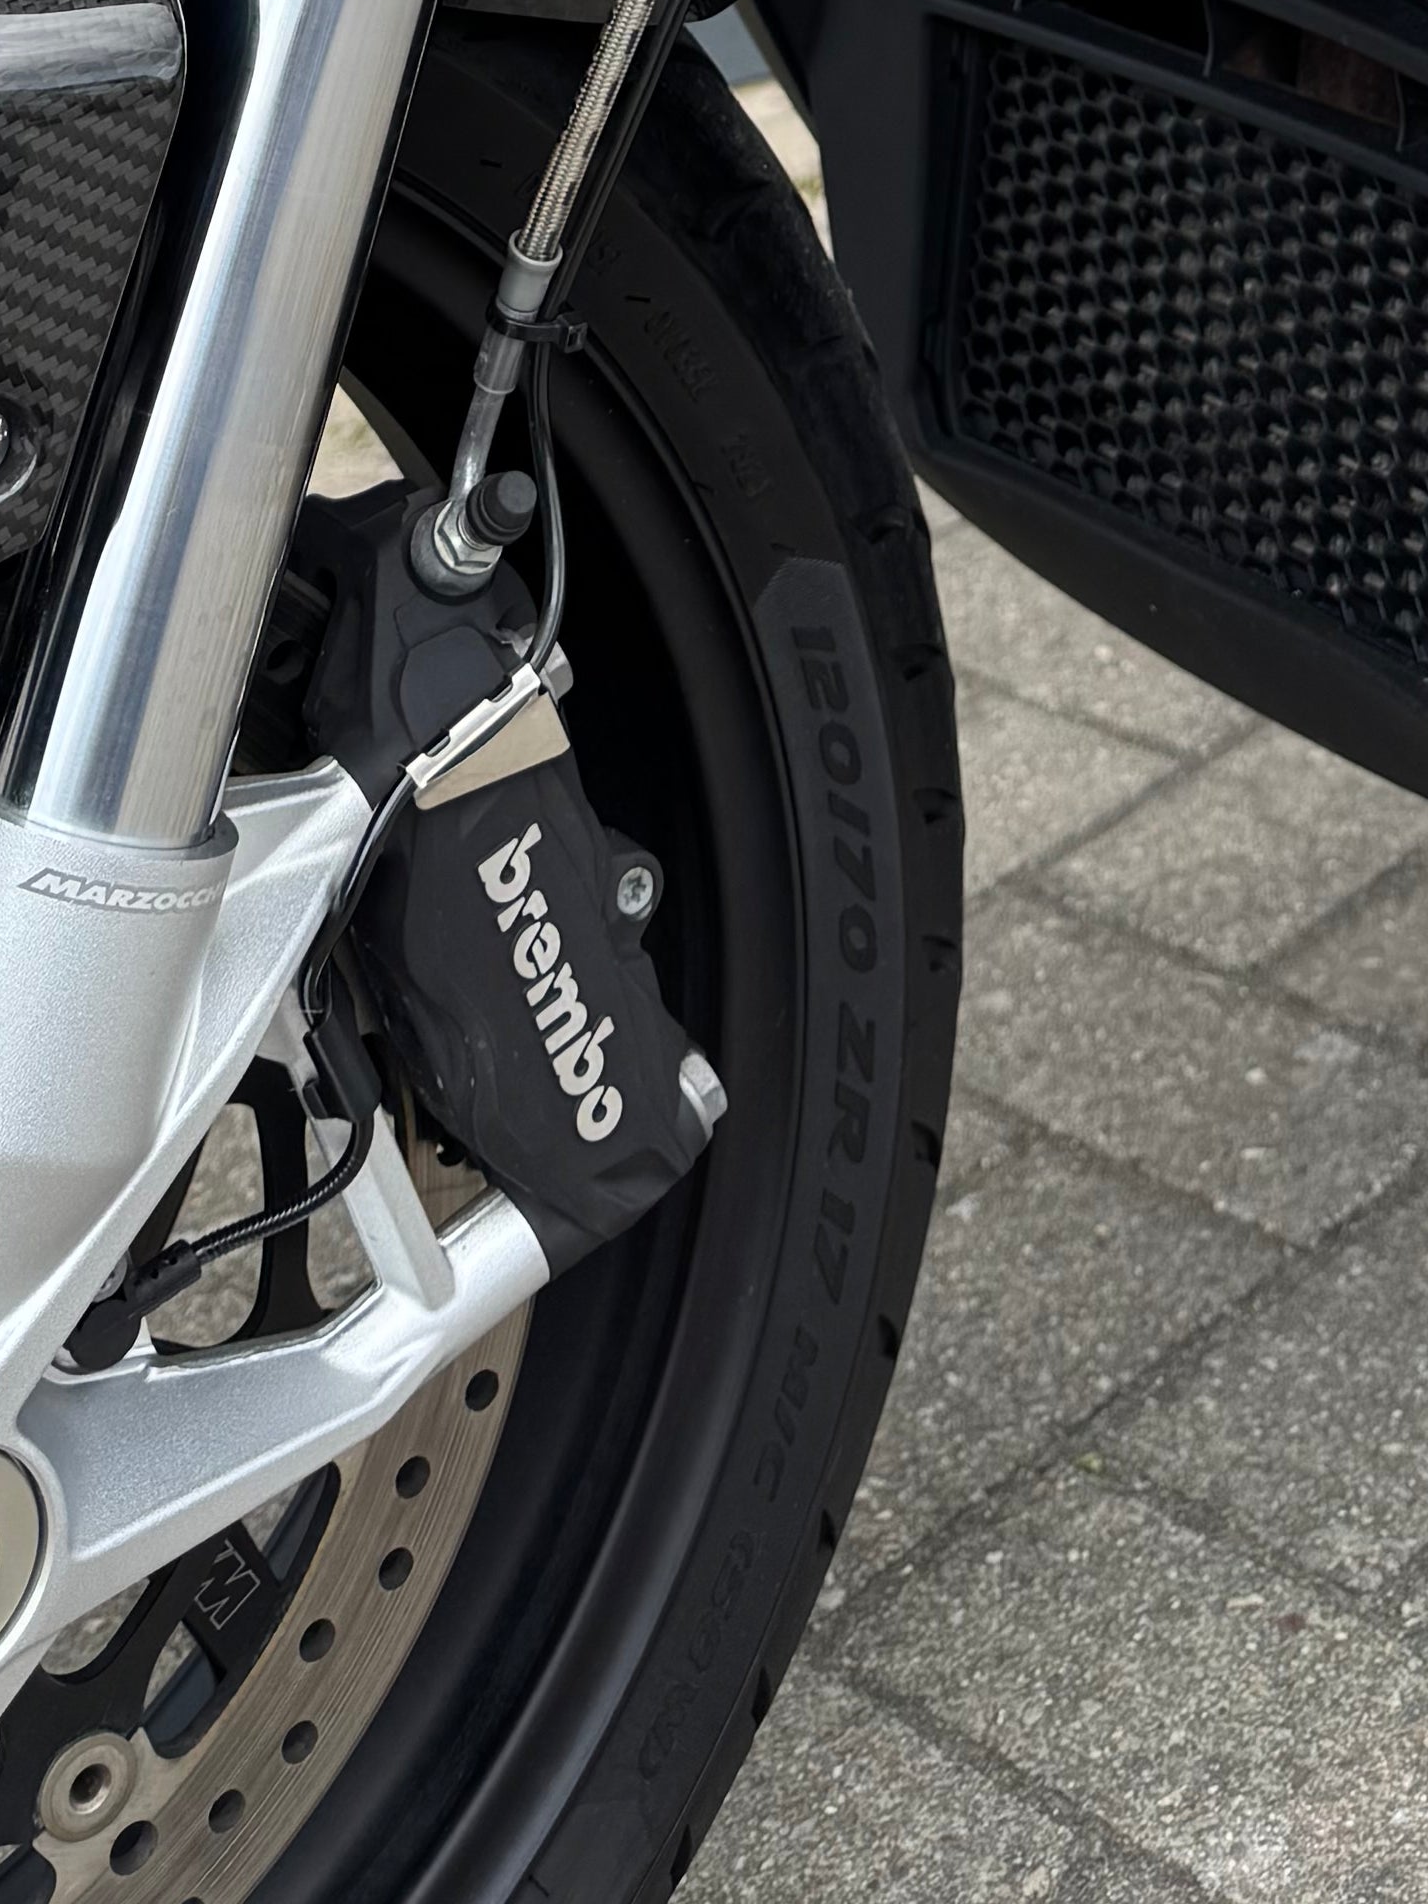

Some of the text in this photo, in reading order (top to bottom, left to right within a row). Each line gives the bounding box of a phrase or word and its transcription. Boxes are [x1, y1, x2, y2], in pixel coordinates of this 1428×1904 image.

[791, 623, 878, 975] 120/70
[476, 822, 624, 1143] brembo
[811, 1188, 856, 1307] 17
